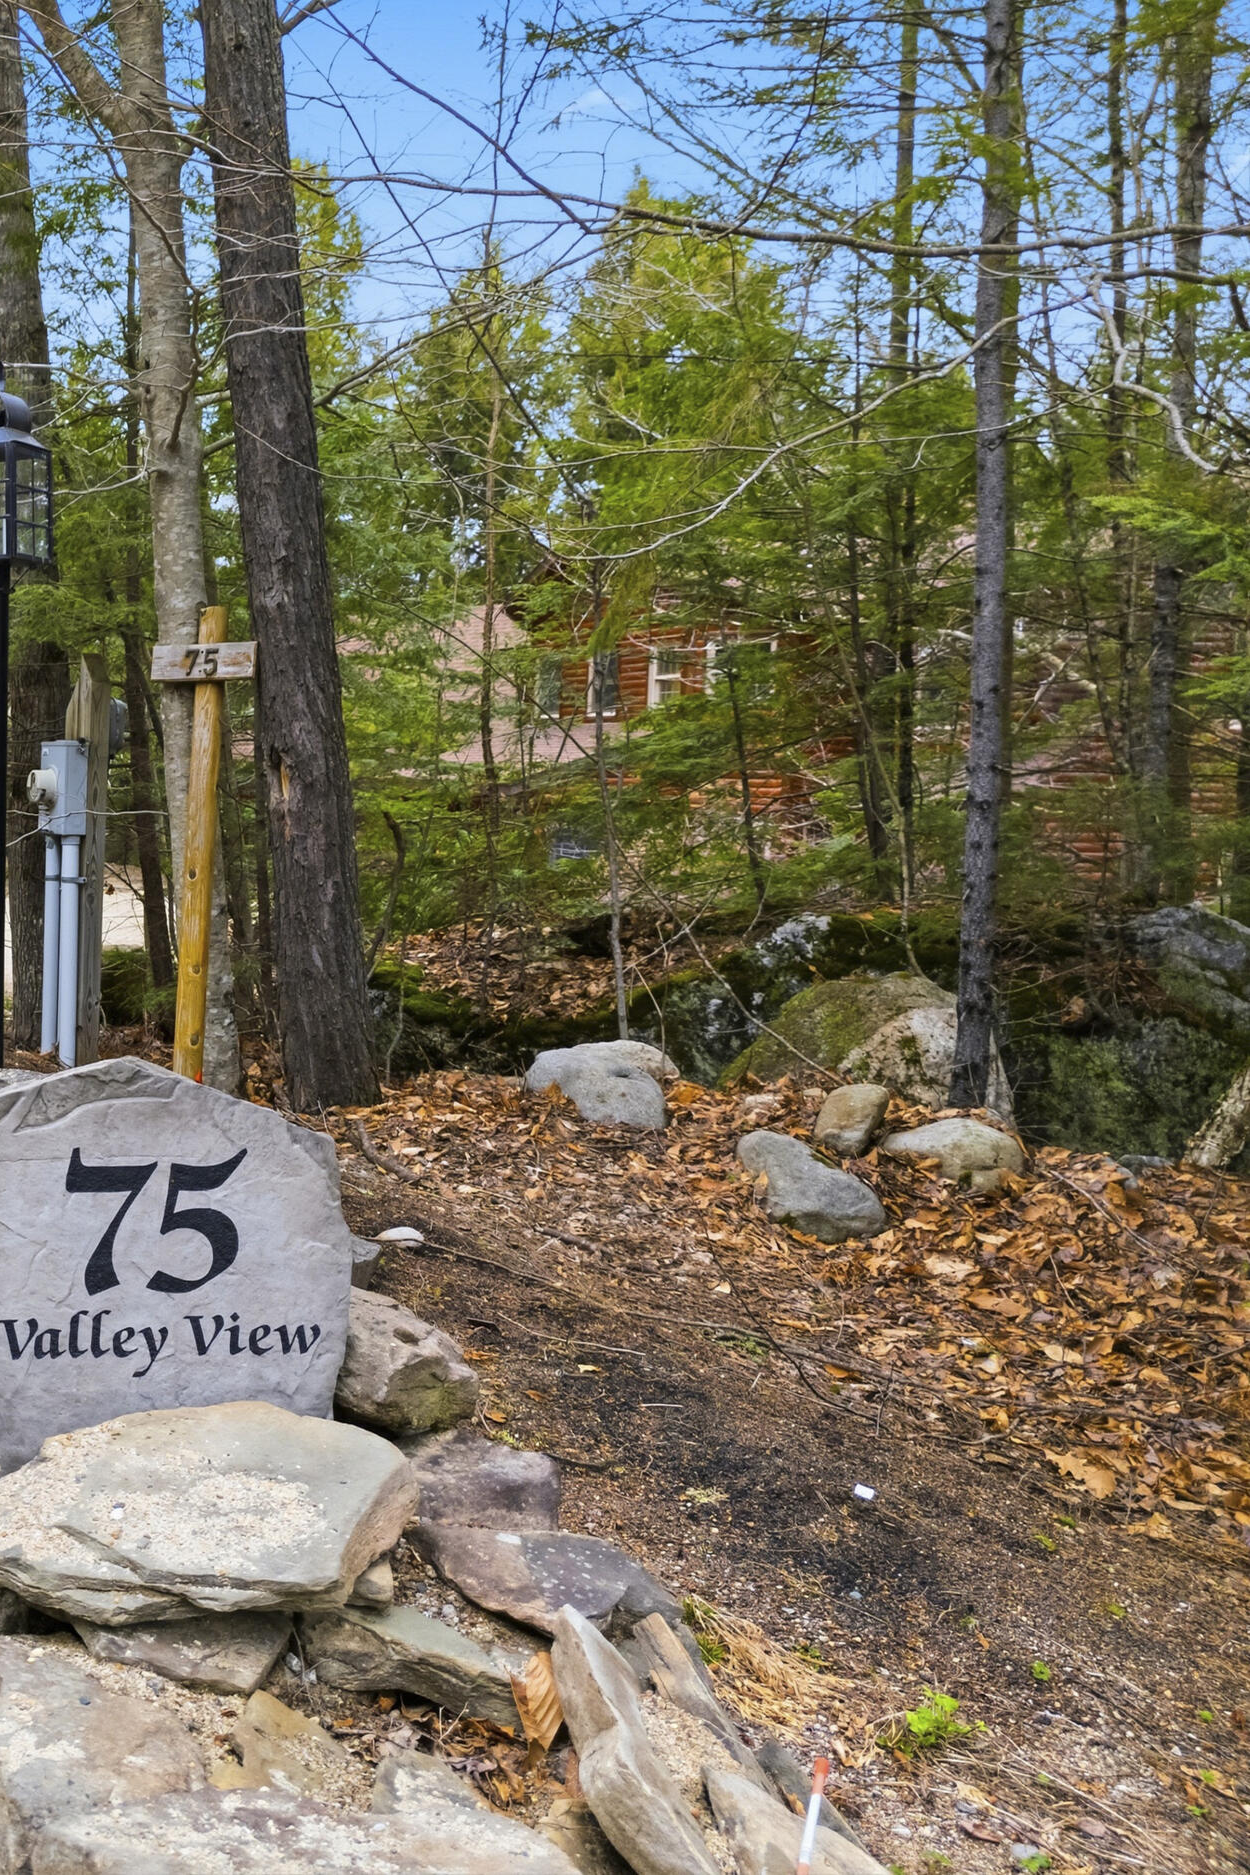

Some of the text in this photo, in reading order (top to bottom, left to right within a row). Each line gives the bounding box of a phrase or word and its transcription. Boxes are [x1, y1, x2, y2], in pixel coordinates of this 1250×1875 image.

[185, 648, 219, 677] 75
[65, 1147, 248, 1296] 75
[183, 1311, 322, 1356] View
